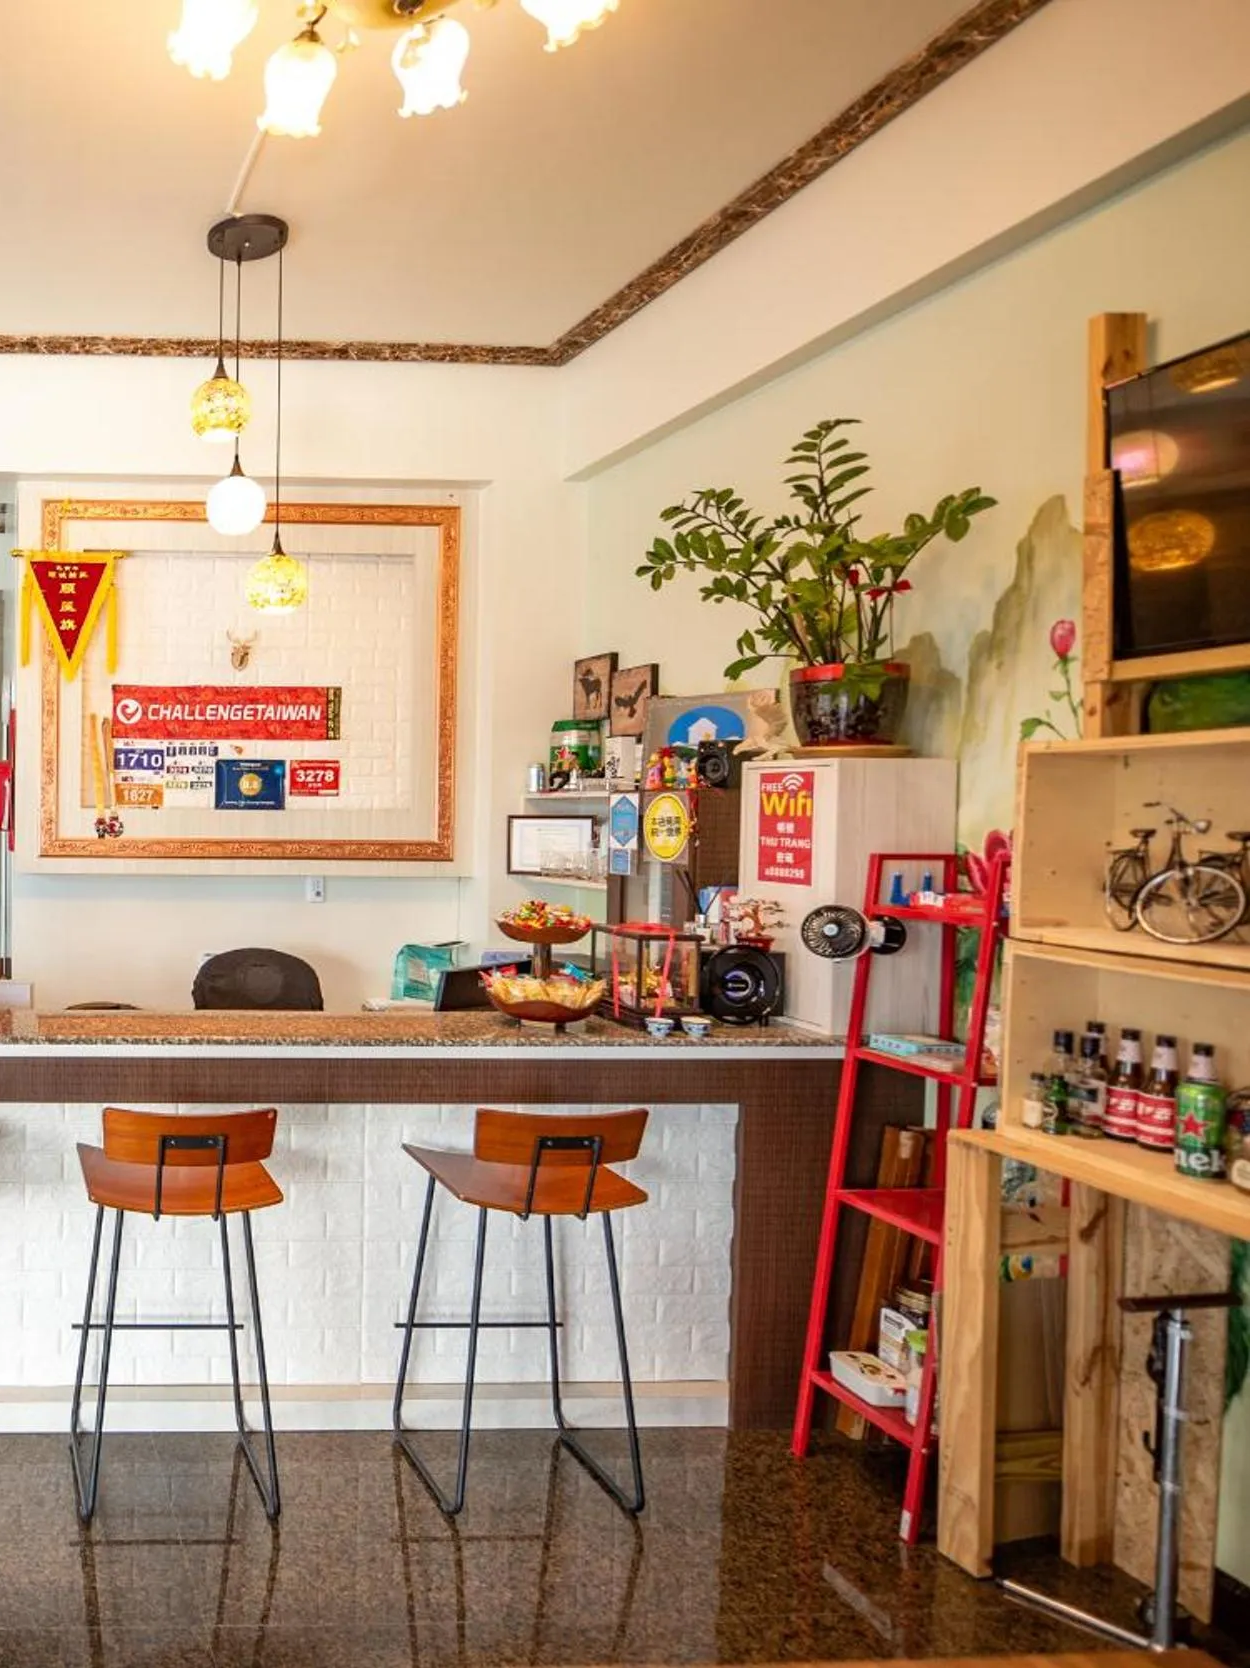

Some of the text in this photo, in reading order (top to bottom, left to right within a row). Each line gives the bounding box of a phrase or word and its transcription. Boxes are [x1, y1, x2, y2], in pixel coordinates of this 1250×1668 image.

[147, 704, 321, 721] CHALLENGETAIWAN
[117, 753, 162, 767] 1710
[296, 769, 334, 782] 3278
[761, 783, 783, 792] FREE
[761, 790, 811, 816] Wifi
[779, 837, 811, 849] TRANG
